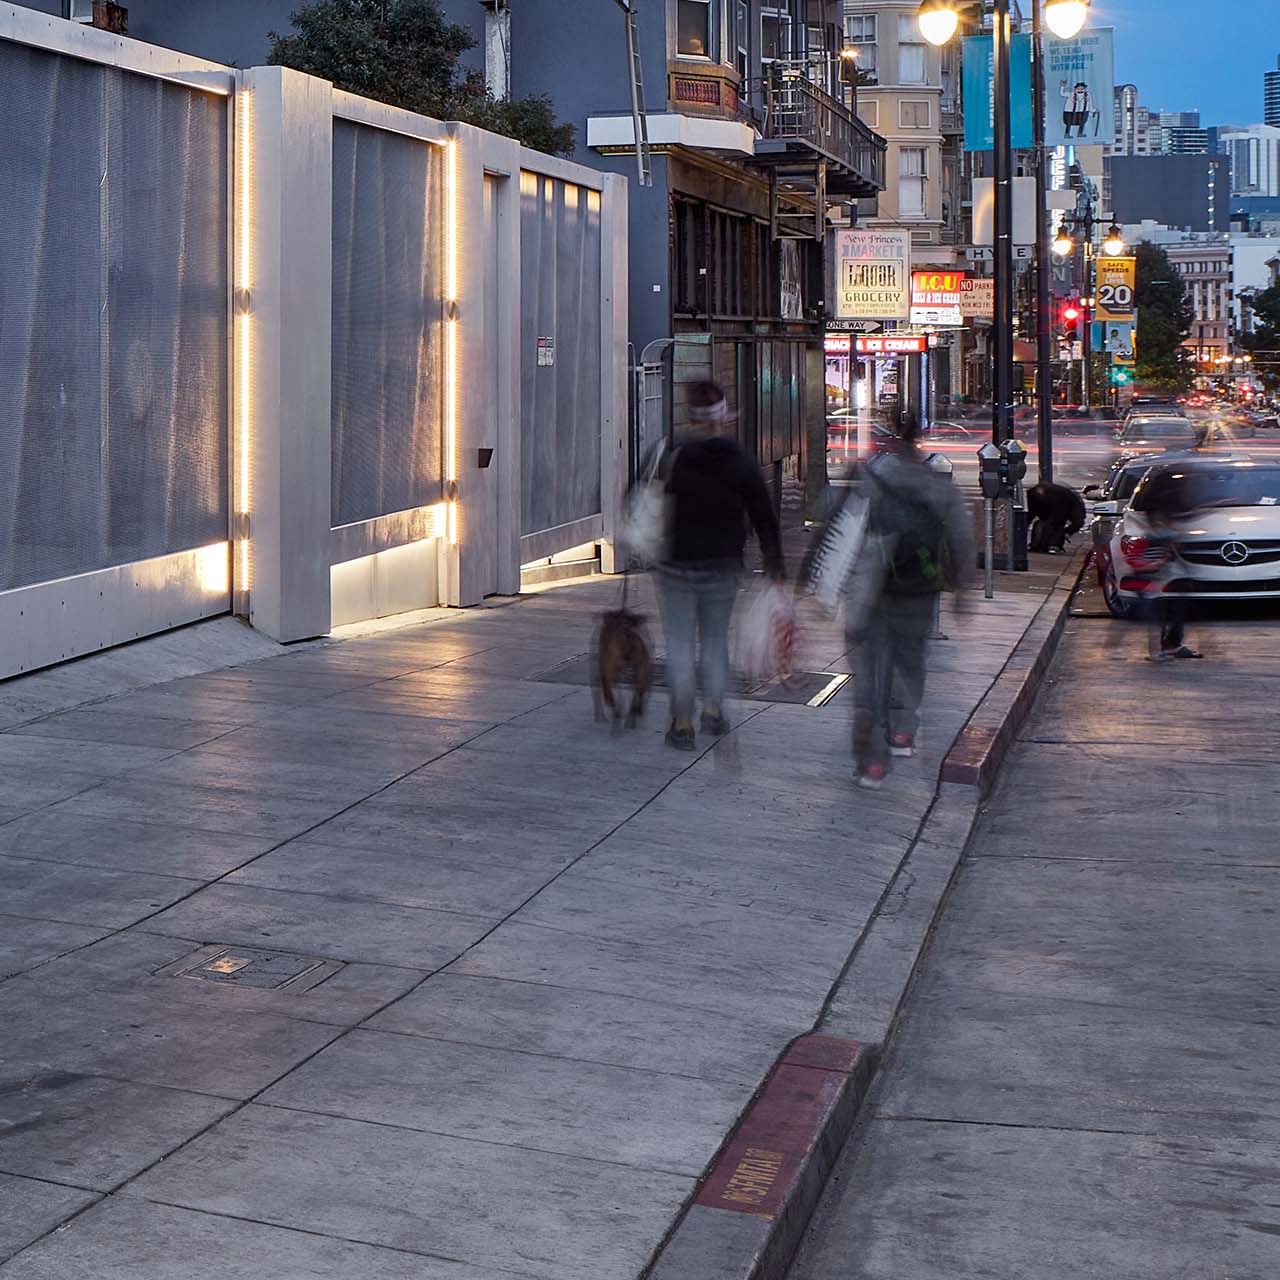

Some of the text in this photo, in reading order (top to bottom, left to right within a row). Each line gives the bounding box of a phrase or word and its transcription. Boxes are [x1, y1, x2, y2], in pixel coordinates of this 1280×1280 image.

[867, 234, 903, 244] Princess
[850, 245, 896, 257] MARKET
[960, 280, 973, 291] NO
[845, 292, 901, 302] GROCERY
[1099, 285, 1132, 305] 20
[827, 320, 865, 329] ONE WAY
[866, 340, 882, 350] ICE
[884, 340, 919, 350] CREAM
